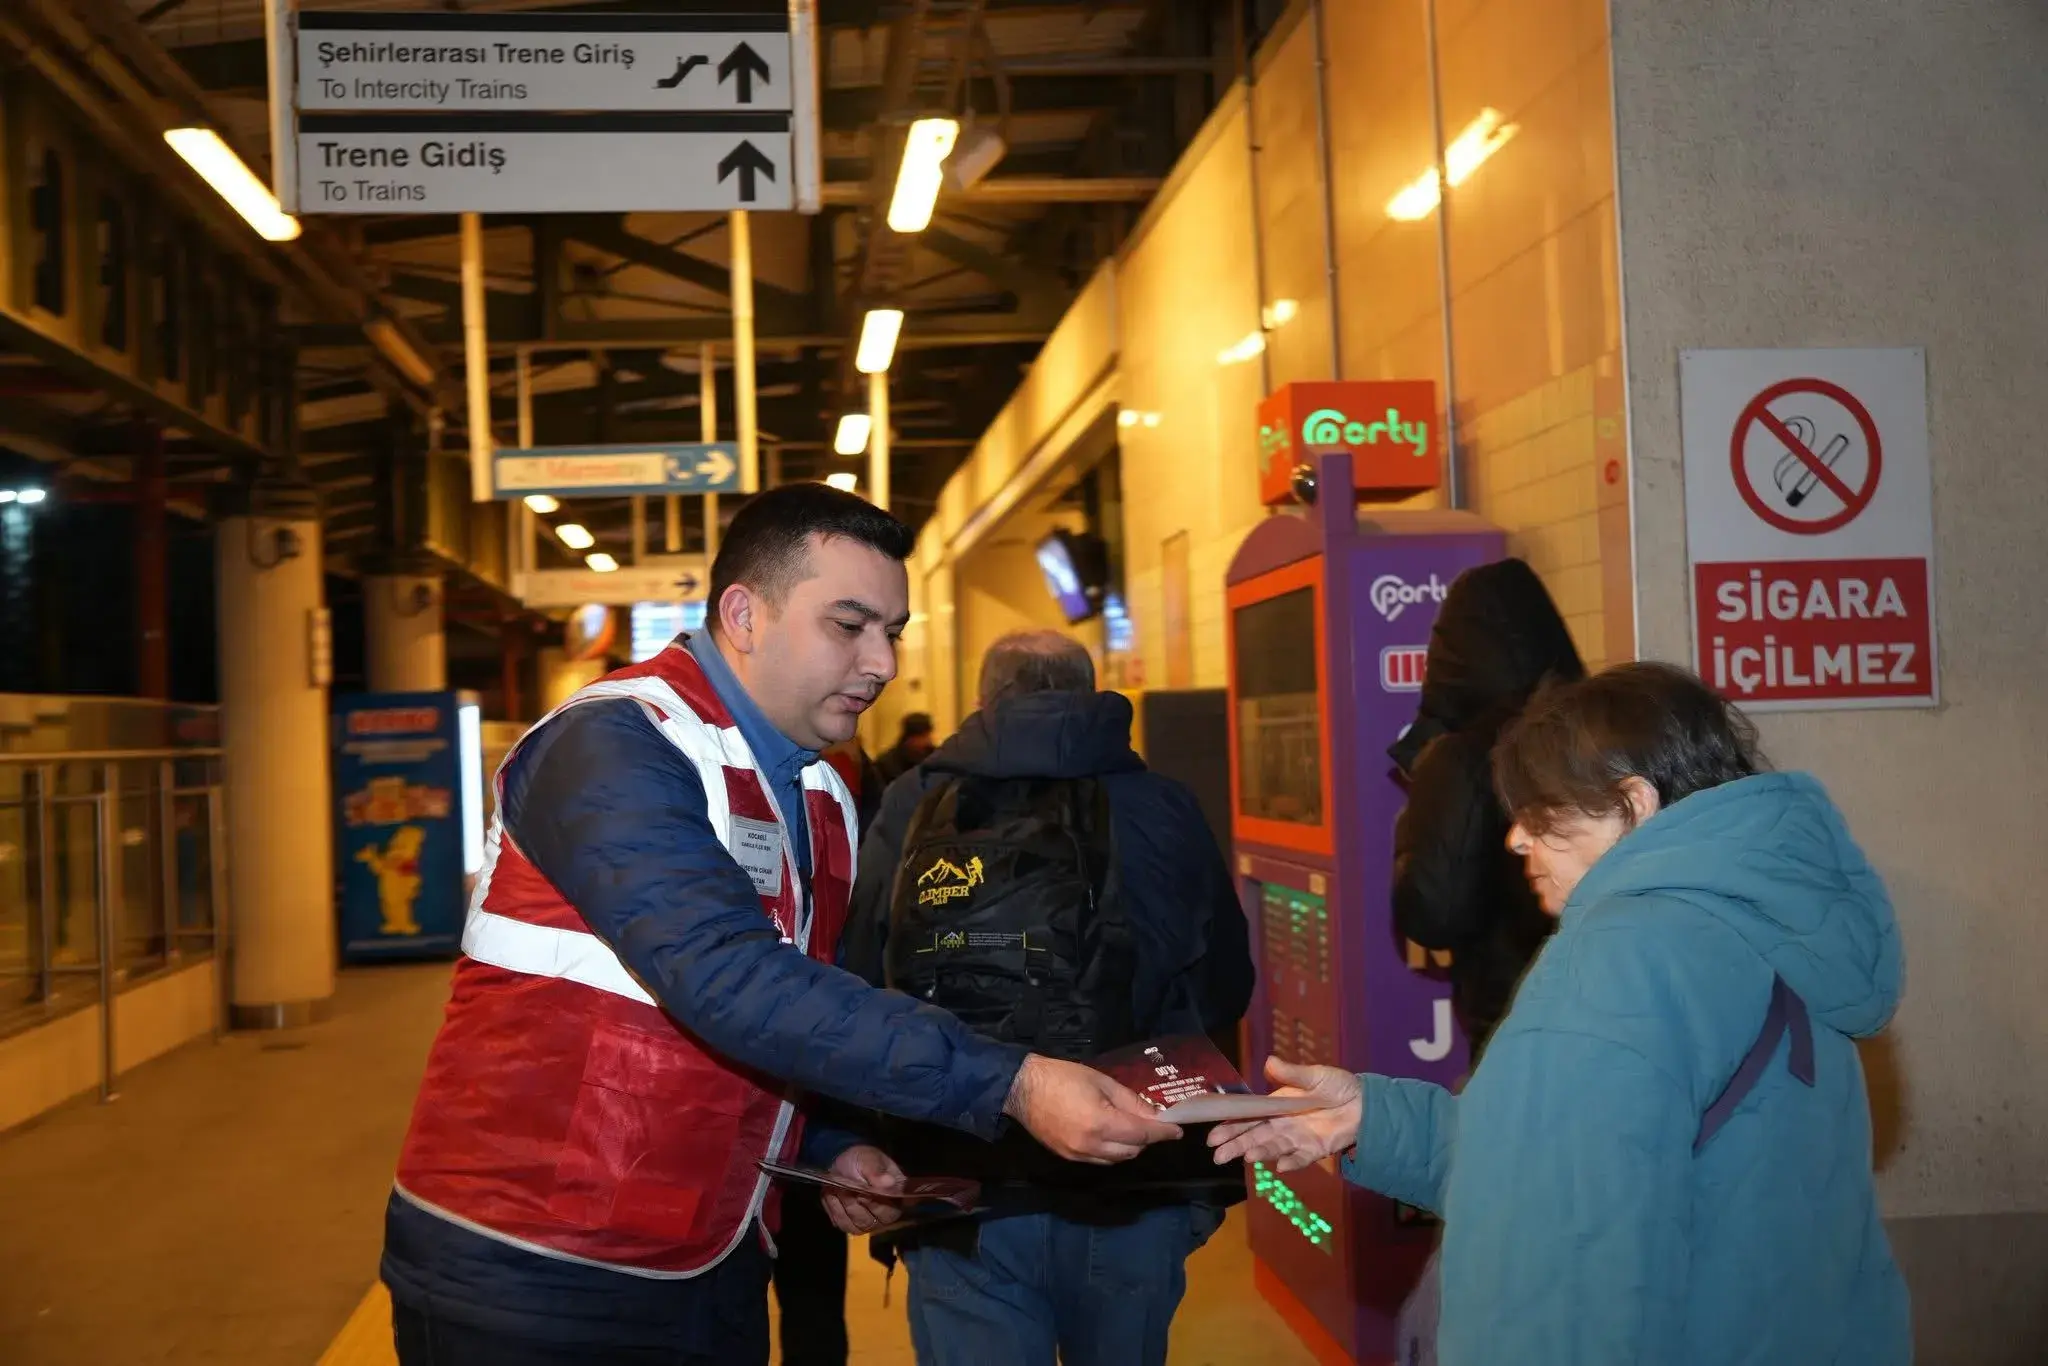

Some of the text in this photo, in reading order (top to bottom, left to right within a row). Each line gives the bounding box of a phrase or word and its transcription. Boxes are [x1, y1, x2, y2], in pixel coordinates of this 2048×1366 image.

[317, 41, 636, 70] Şehirlerarası Trene Giriş
[319, 79, 528, 104] To Intercity Trains
[317, 142, 507, 174] Trene Gidiş
[319, 181, 427, 203] To Trains
[1716, 568, 1907, 623] SİGARA
[1713, 635, 1917, 694] İÇİLMEZ
